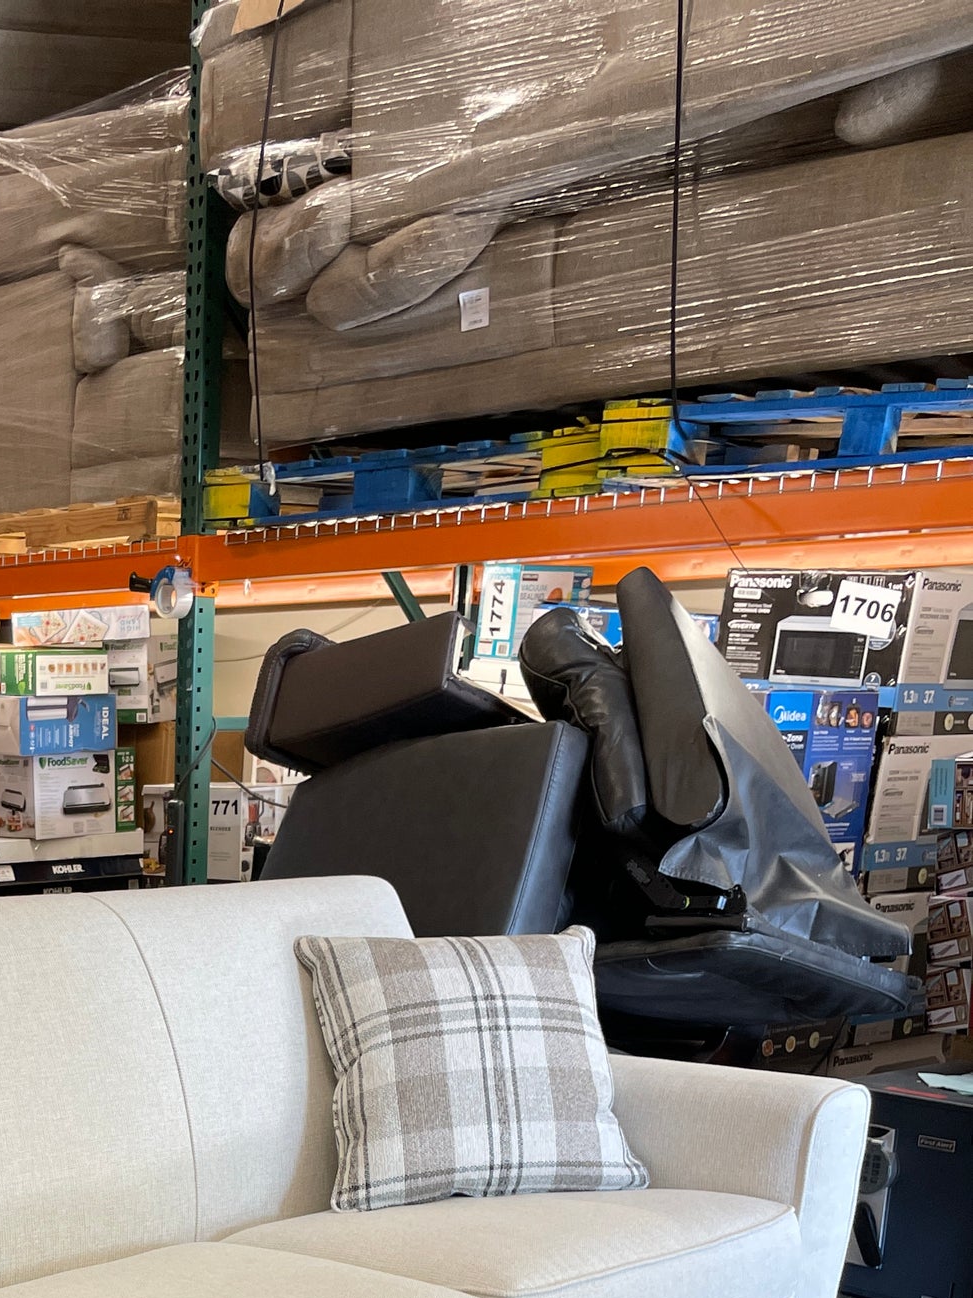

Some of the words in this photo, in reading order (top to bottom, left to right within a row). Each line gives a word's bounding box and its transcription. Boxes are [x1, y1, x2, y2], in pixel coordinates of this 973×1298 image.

[730, 575, 794, 589] Panasonic
[922, 578, 962, 592] Panasonic
[489, 580, 505, 637] 1774
[840, 594, 895, 622] 1706
[774, 705, 807, 723] Midea
[102, 706, 110, 741] IDEAL
[888, 742, 930, 755] Panasonic
[47, 756, 89, 768] FoodSaver
[212, 800, 238, 815] 771
[52, 864, 85, 875] KOHLER
[833, 1052, 874, 1067] Panasonic
